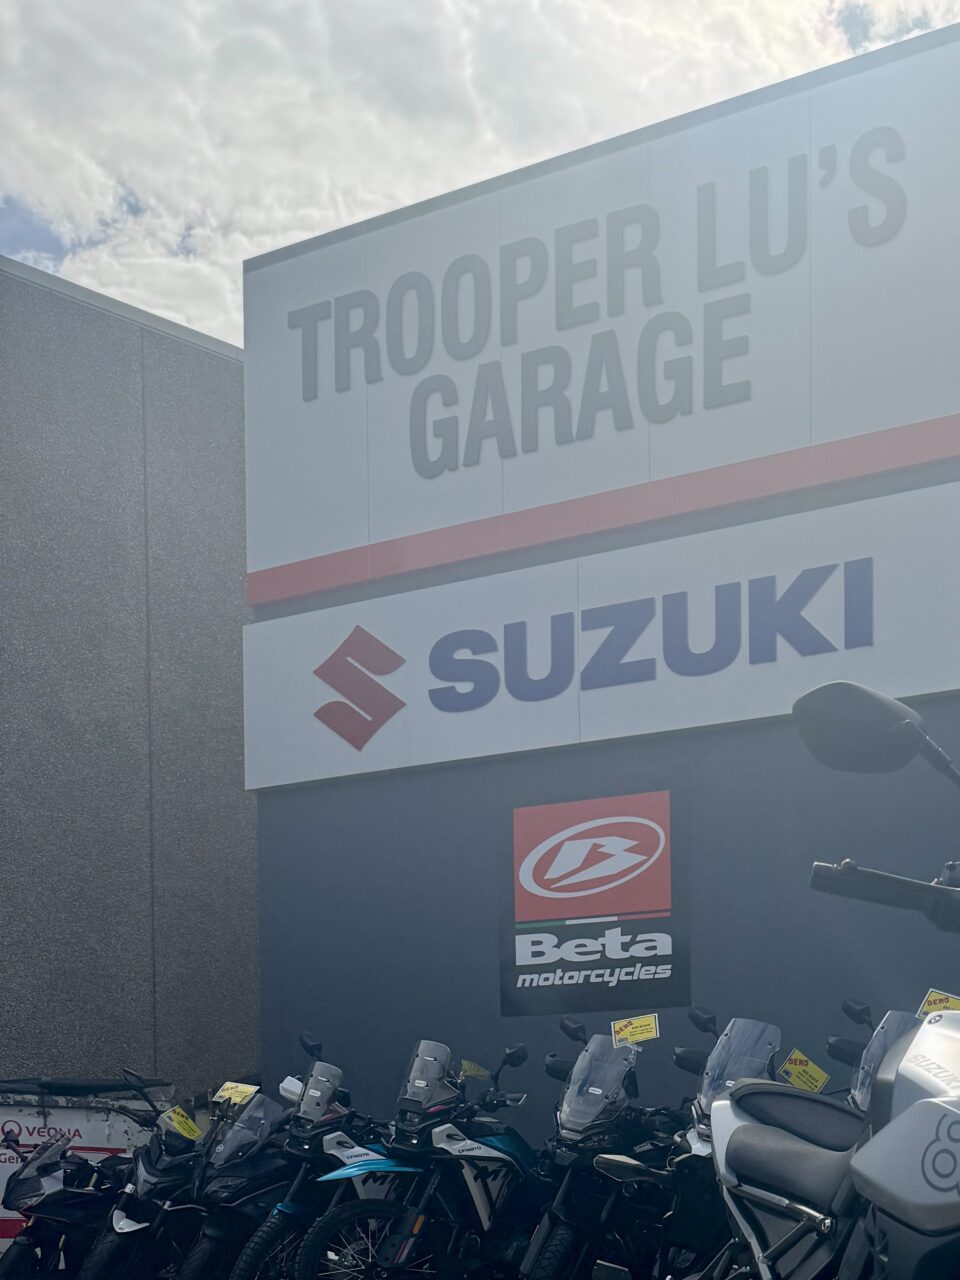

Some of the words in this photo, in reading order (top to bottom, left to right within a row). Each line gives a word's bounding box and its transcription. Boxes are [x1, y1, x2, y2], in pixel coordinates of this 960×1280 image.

[287, 202, 664, 402] TROOPER
[696, 125, 908, 293] LU'S
[408, 292, 752, 480] GARAGE
[427, 556, 874, 713] SUZUKI
[515, 926, 673, 966] Beta
[516, 963, 673, 988] motorcycles
[927, 997, 950, 1006] DEMO
[615, 1020, 633, 1035] DEMO
[788, 1058, 809, 1067] DEMO
